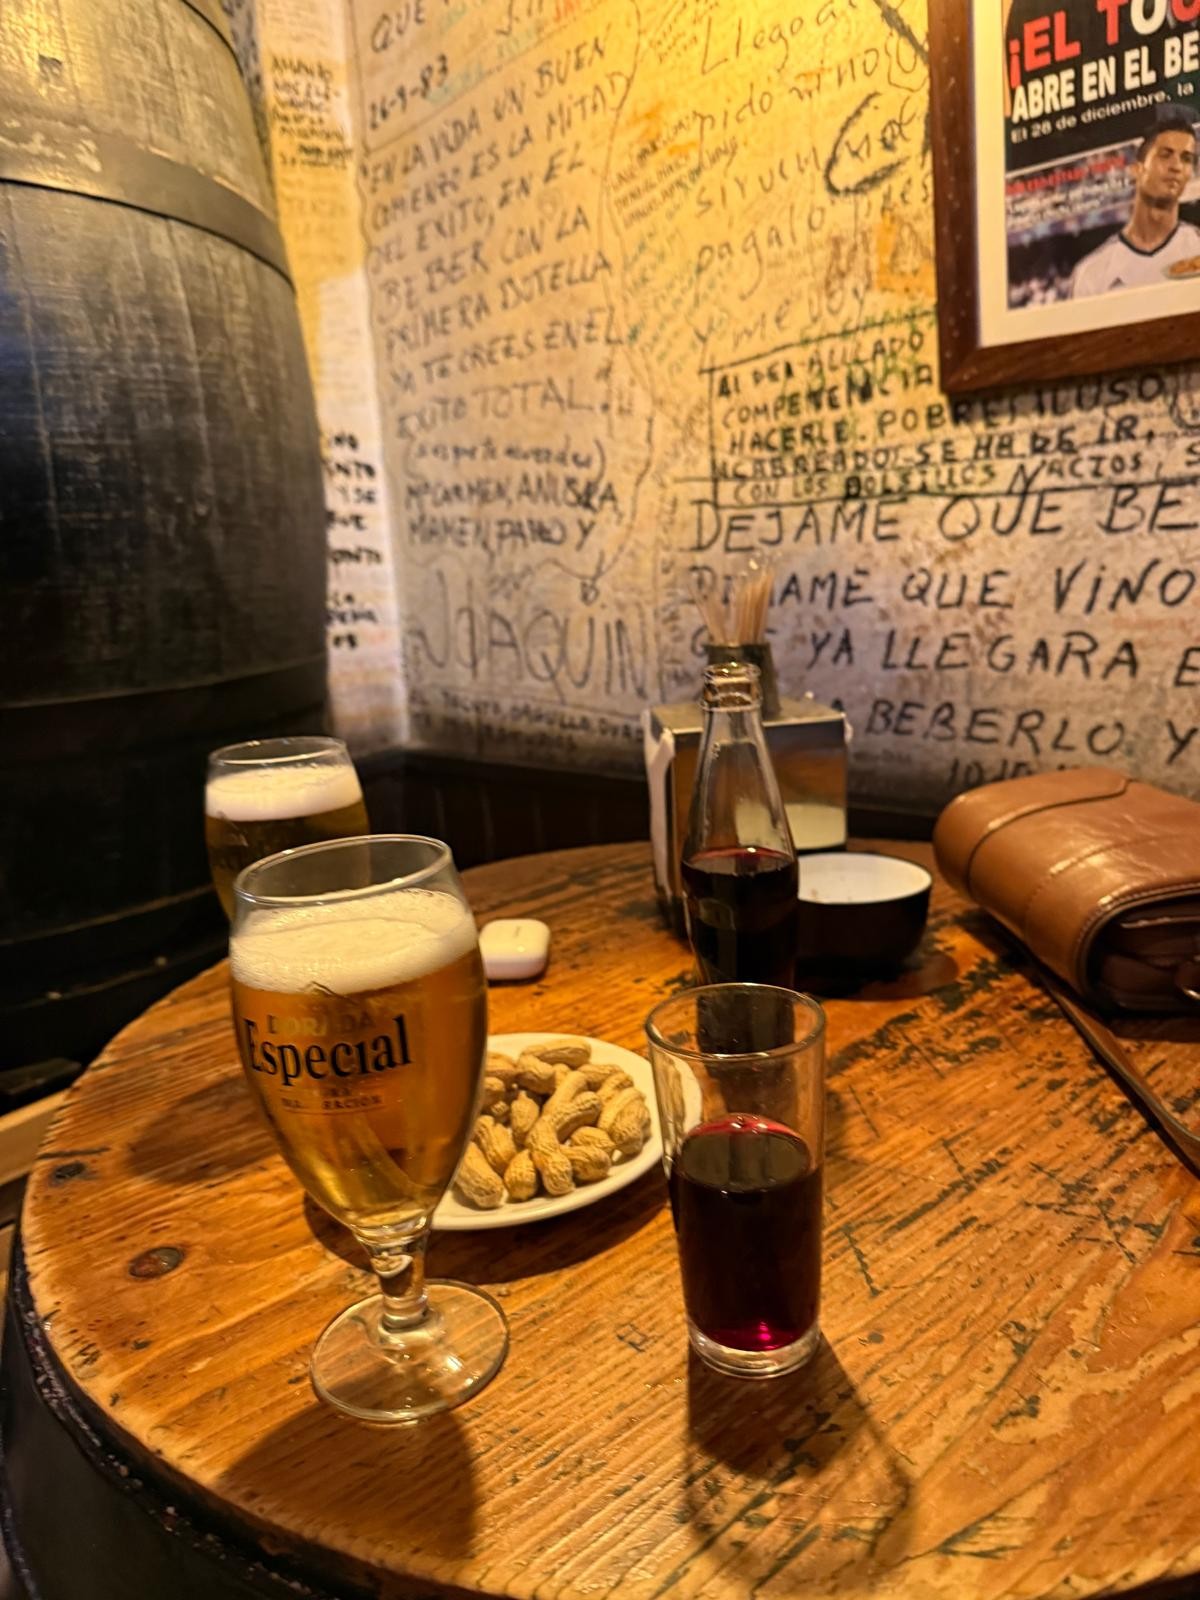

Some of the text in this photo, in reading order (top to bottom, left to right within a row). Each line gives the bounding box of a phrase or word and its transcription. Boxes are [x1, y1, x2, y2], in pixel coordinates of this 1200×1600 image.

[1012, 68, 1076, 124] ABRE
[1082, 55, 1117, 103] EN
[1124, 46, 1157, 91] EL
[1055, 112, 1078, 132] de
[1177, 82, 1195, 97] la
[543, 141, 584, 184] EL
[556, 205, 591, 242] LA
[684, 498, 906, 552] DEJAME
[938, 484, 1064, 542] QUE
[901, 567, 1014, 608] QUE
[806, 627, 854, 671] YA
[881, 629, 1139, 680] LLEGARA
[865, 700, 1126, 757] BEBERLO
